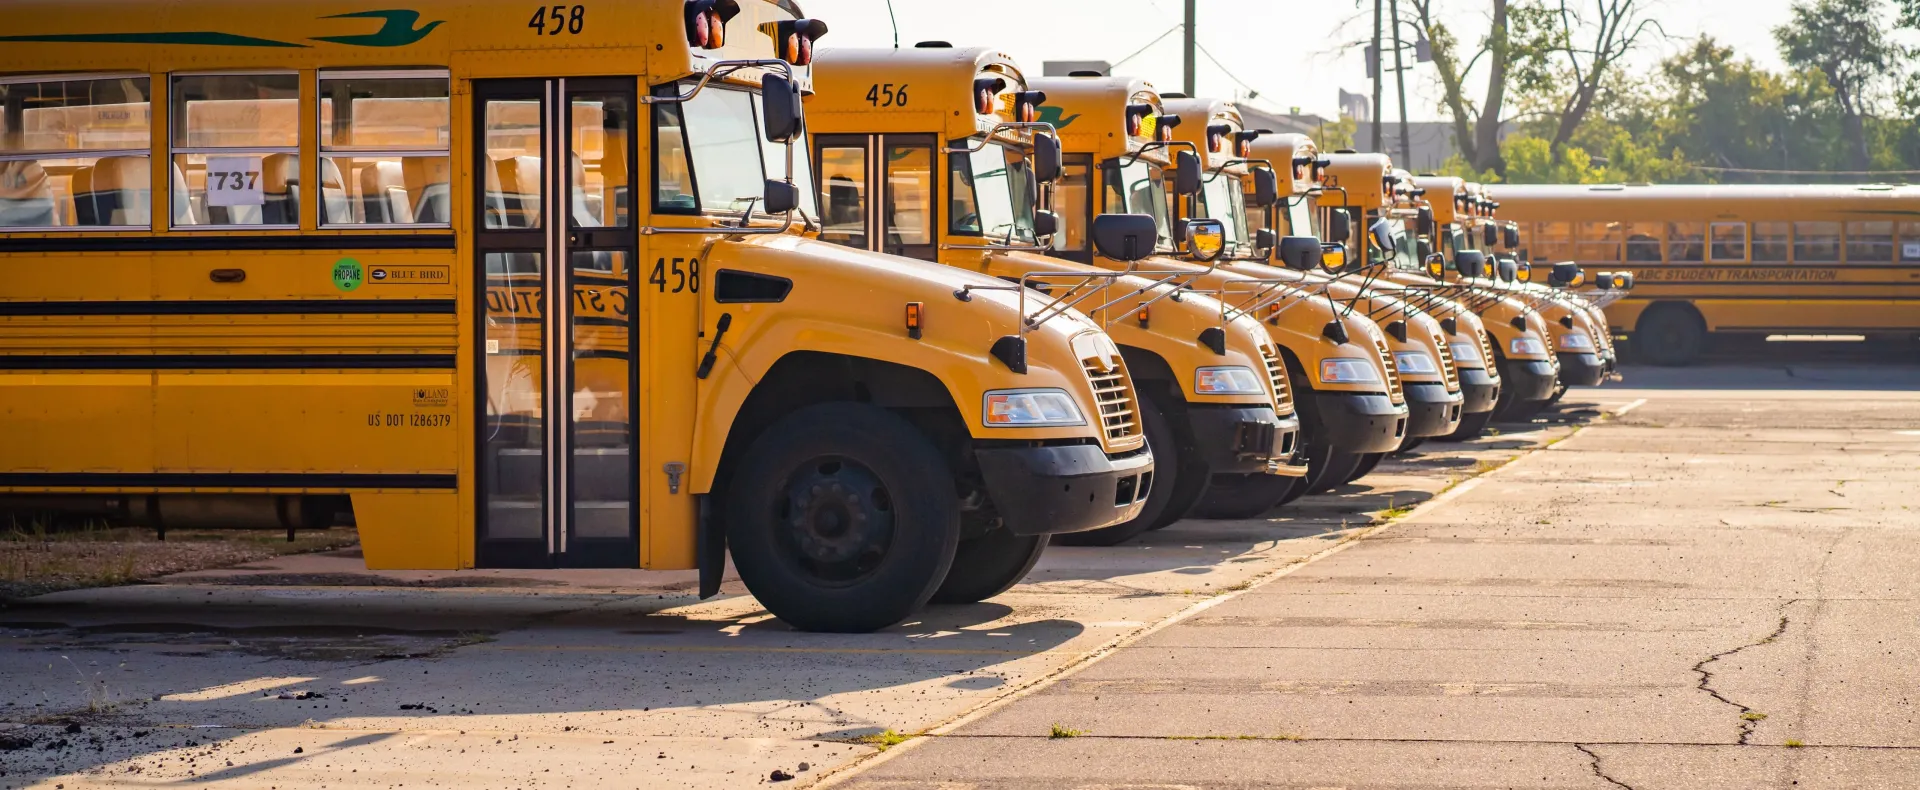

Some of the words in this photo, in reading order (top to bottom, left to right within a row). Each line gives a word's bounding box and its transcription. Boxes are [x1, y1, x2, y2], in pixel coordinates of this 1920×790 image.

[528, 4, 585, 36] 458
[865, 83, 908, 107] 456
[207, 171, 259, 190] 737
[334, 269, 360, 280] PROPANE
[391, 271, 415, 279] BLUE
[420, 271, 444, 279] BIRD
[649, 257, 699, 294] 458
[1637, 269, 1661, 281] ABC
[1665, 269, 1722, 281] STUDENT
[1727, 269, 1837, 281] TRANSPORTATION
[413, 389, 449, 399] HOLLAND
[368, 414, 380, 426] US
[386, 414, 404, 426] DOT
[410, 414, 451, 426] 1286379
